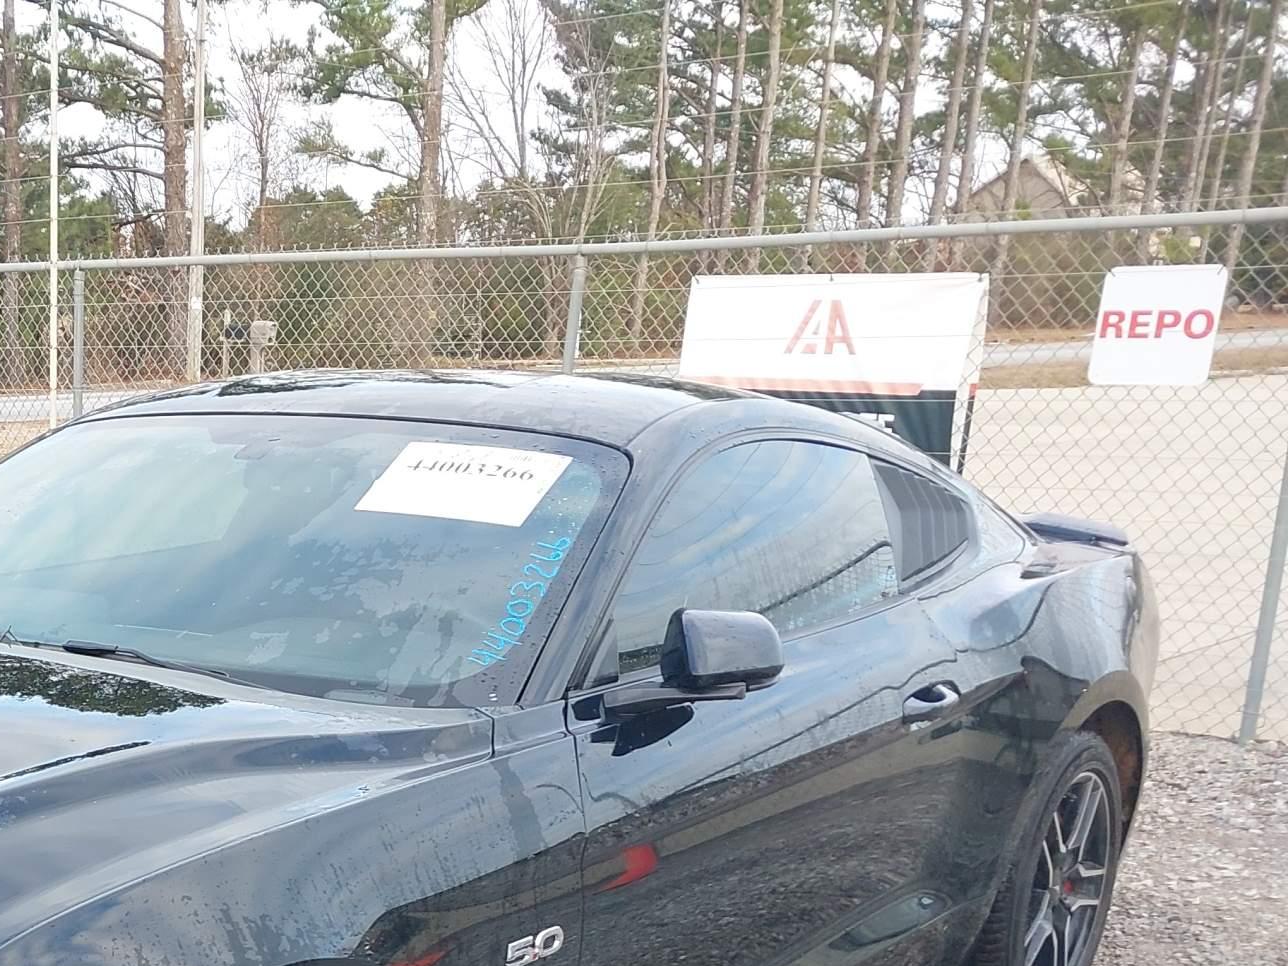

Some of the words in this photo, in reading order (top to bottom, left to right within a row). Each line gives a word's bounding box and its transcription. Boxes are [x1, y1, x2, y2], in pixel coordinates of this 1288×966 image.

[1099, 309, 1215, 340] REPO
[407, 459, 534, 481] 44003266
[466, 537, 571, 666] 44003266
